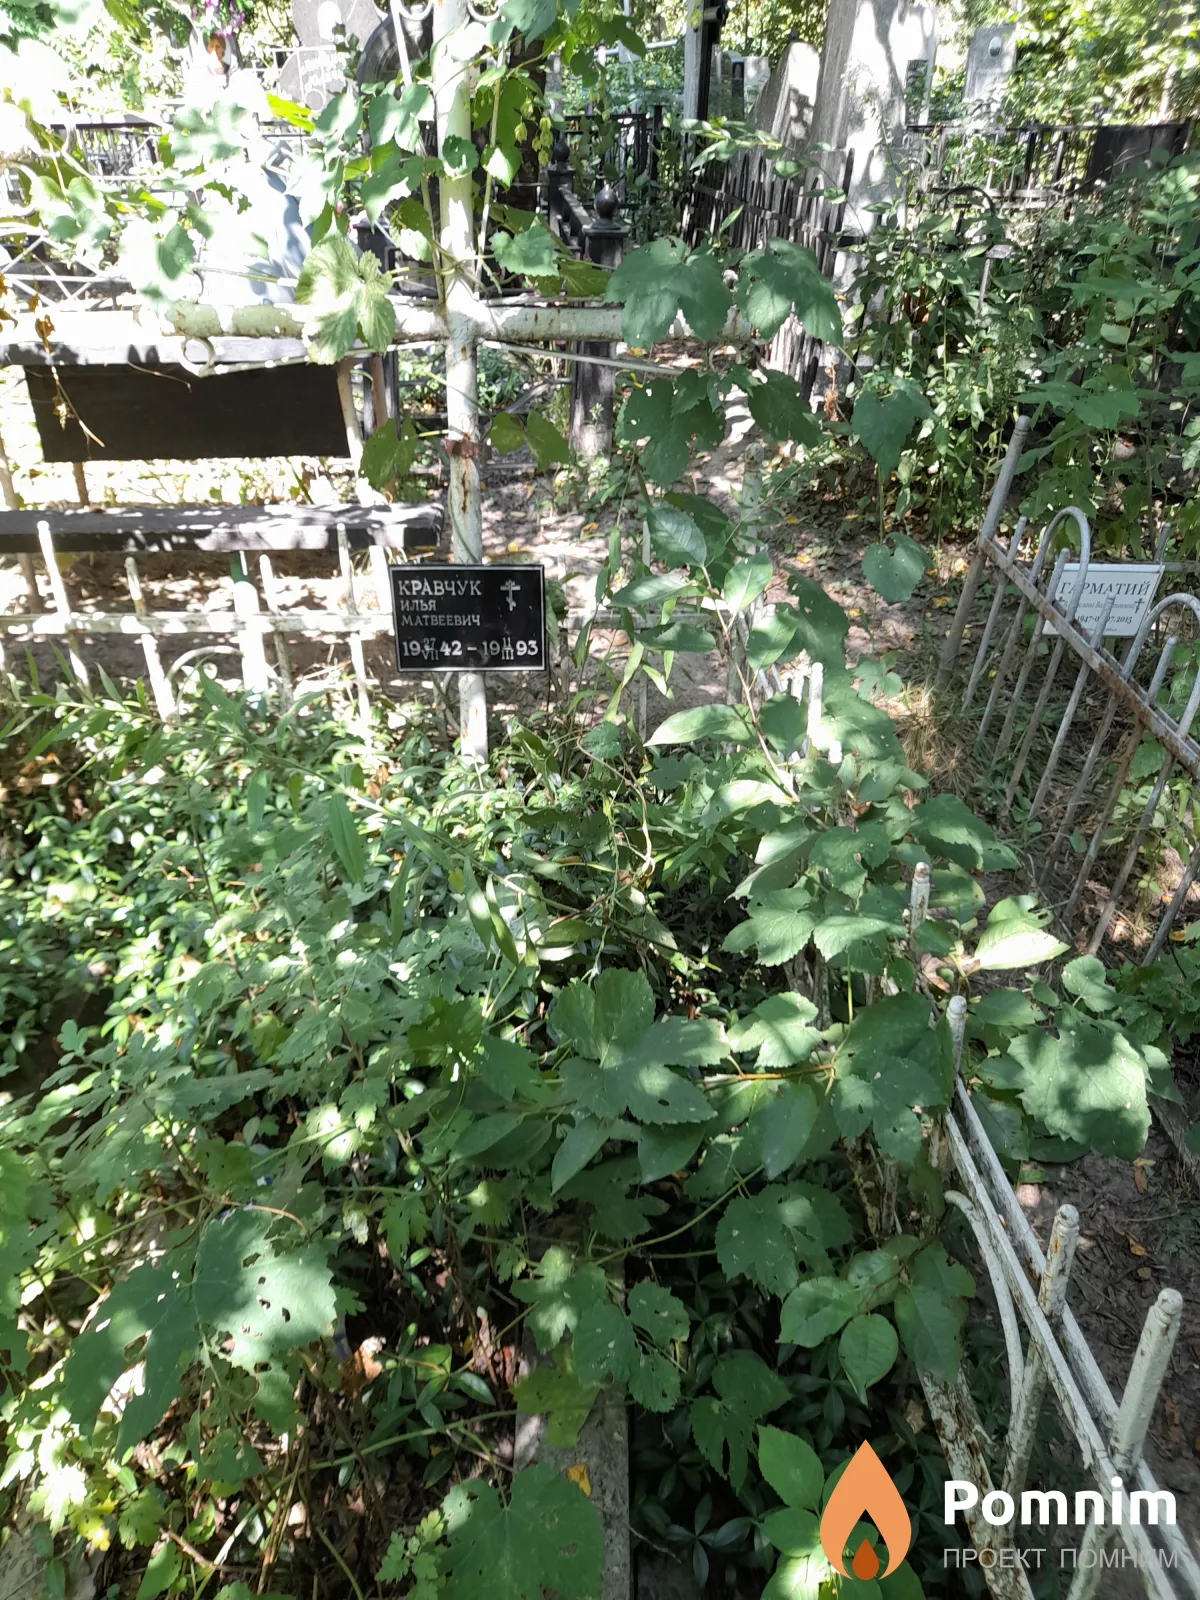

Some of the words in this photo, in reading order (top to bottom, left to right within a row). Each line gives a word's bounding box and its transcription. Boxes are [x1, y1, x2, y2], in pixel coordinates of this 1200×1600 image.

[398, 579, 482, 596] КРАВЧУК
[400, 600, 437, 611] ИЛЬЯ
[401, 614, 481, 626] МАТВЕЕВИЧ
